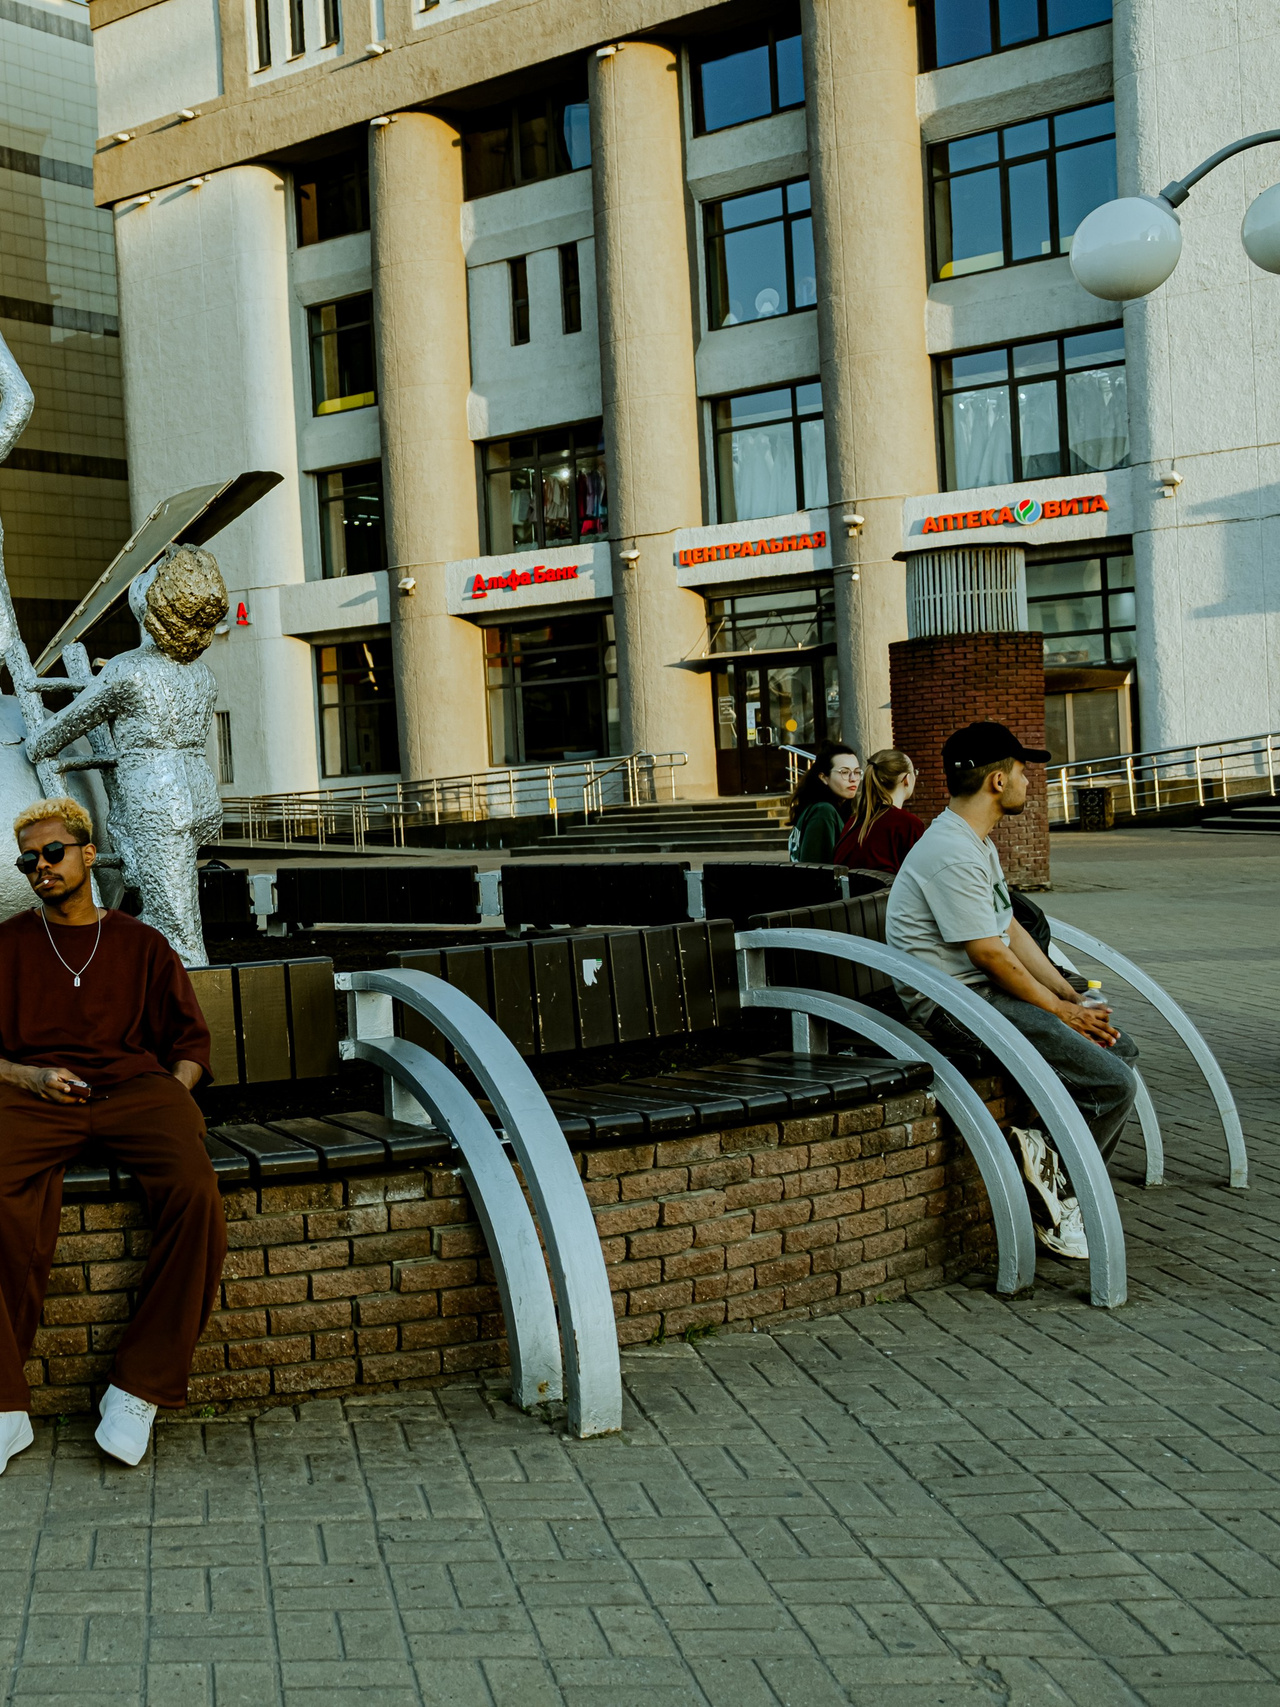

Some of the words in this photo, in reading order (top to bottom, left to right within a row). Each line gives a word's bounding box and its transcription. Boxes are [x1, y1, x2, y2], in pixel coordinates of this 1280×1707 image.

[922, 506, 1015, 534] АПТЕКА
[1044, 494, 1109, 518] ВИТА
[679, 531, 826, 567] ЦЕНТРАЛЬНАЯ
